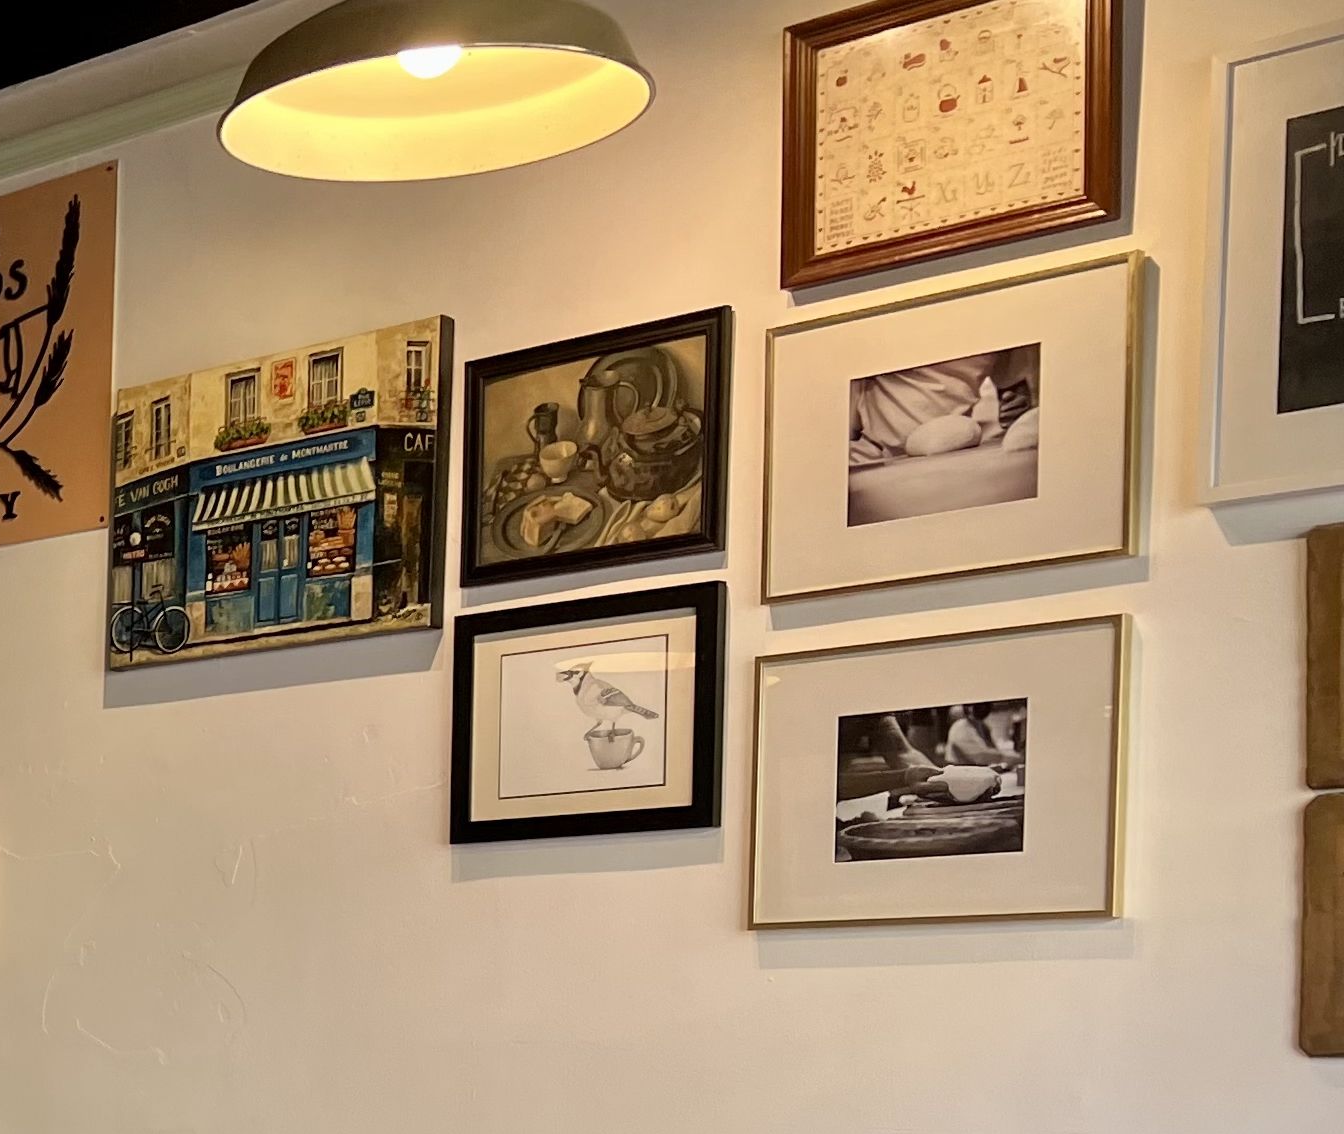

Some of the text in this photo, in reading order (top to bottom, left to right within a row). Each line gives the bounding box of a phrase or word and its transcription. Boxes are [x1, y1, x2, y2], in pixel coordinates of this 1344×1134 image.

[215, 452, 275, 477] BOULANGERIE
[292, 440, 349, 461] MONTMARTRE
[130, 485, 150, 502] VAN
[152, 474, 178, 495] GOGH
